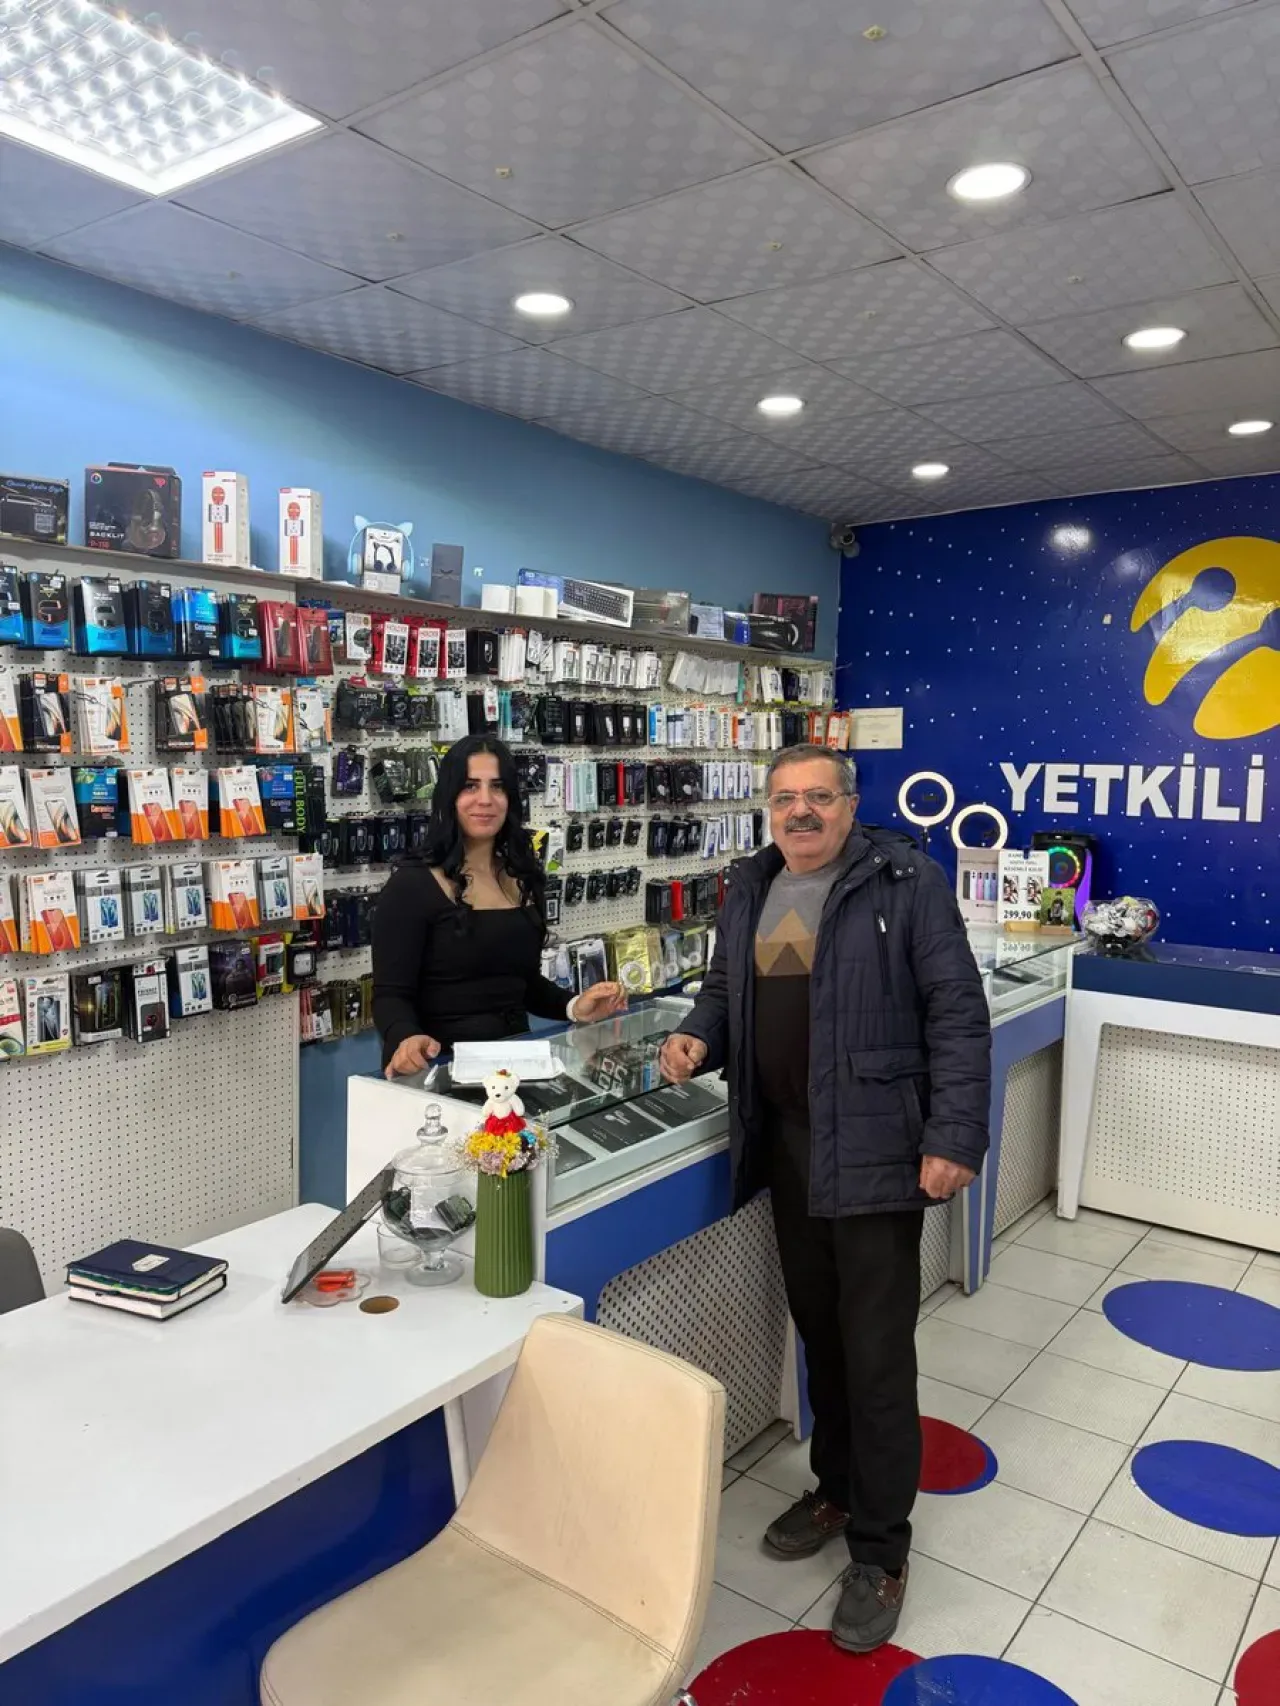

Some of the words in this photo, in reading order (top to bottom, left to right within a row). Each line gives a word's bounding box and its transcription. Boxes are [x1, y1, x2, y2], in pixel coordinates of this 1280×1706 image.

[294, 769, 304, 799] FULL
[1000, 753, 1265, 822] YETKİLİ
[296, 800, 307, 834] BODY
[1003, 909, 1032, 920] 299,90
